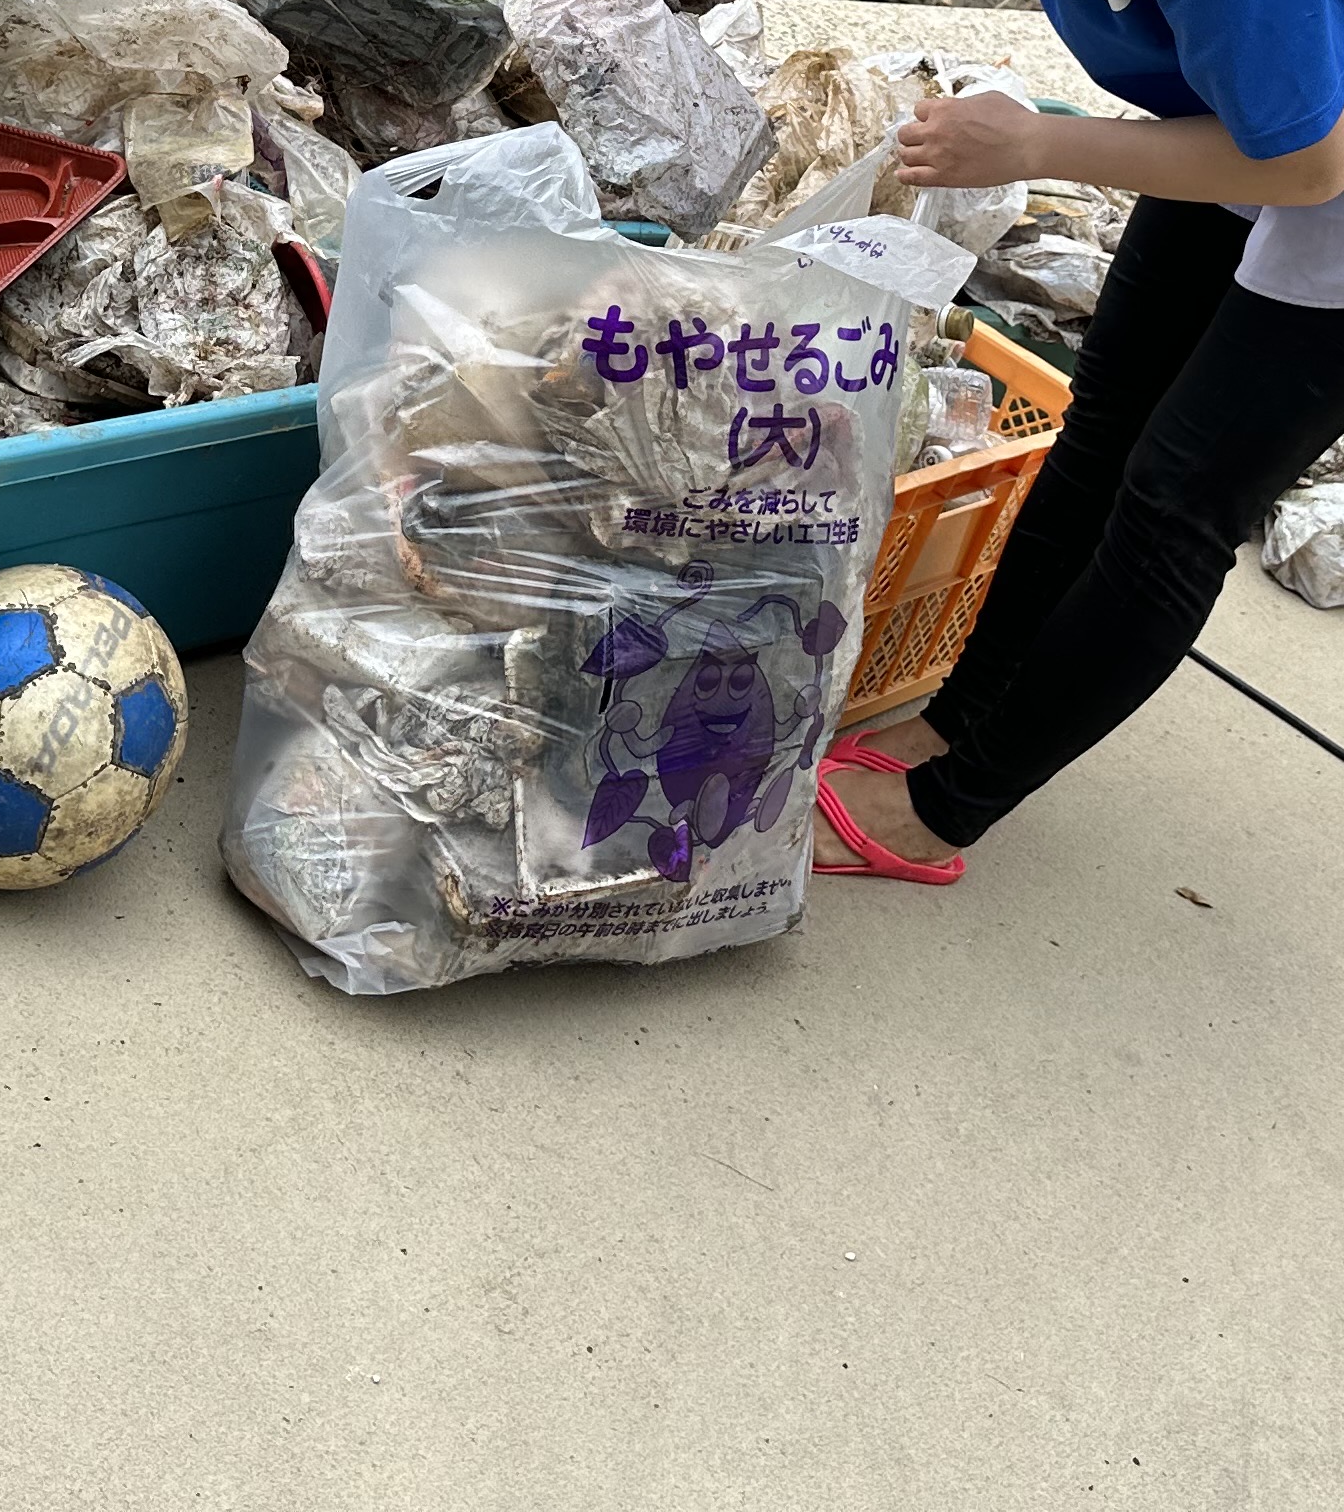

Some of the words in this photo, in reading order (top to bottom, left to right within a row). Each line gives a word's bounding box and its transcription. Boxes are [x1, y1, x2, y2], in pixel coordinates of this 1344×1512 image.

[581, 304, 899, 394] もやせるごみ
[728, 403, 821, 470] (大)
[621, 508, 860, 545] 環境にやさしいエコ生活
[683, 486, 836, 515] ごみを減らして
